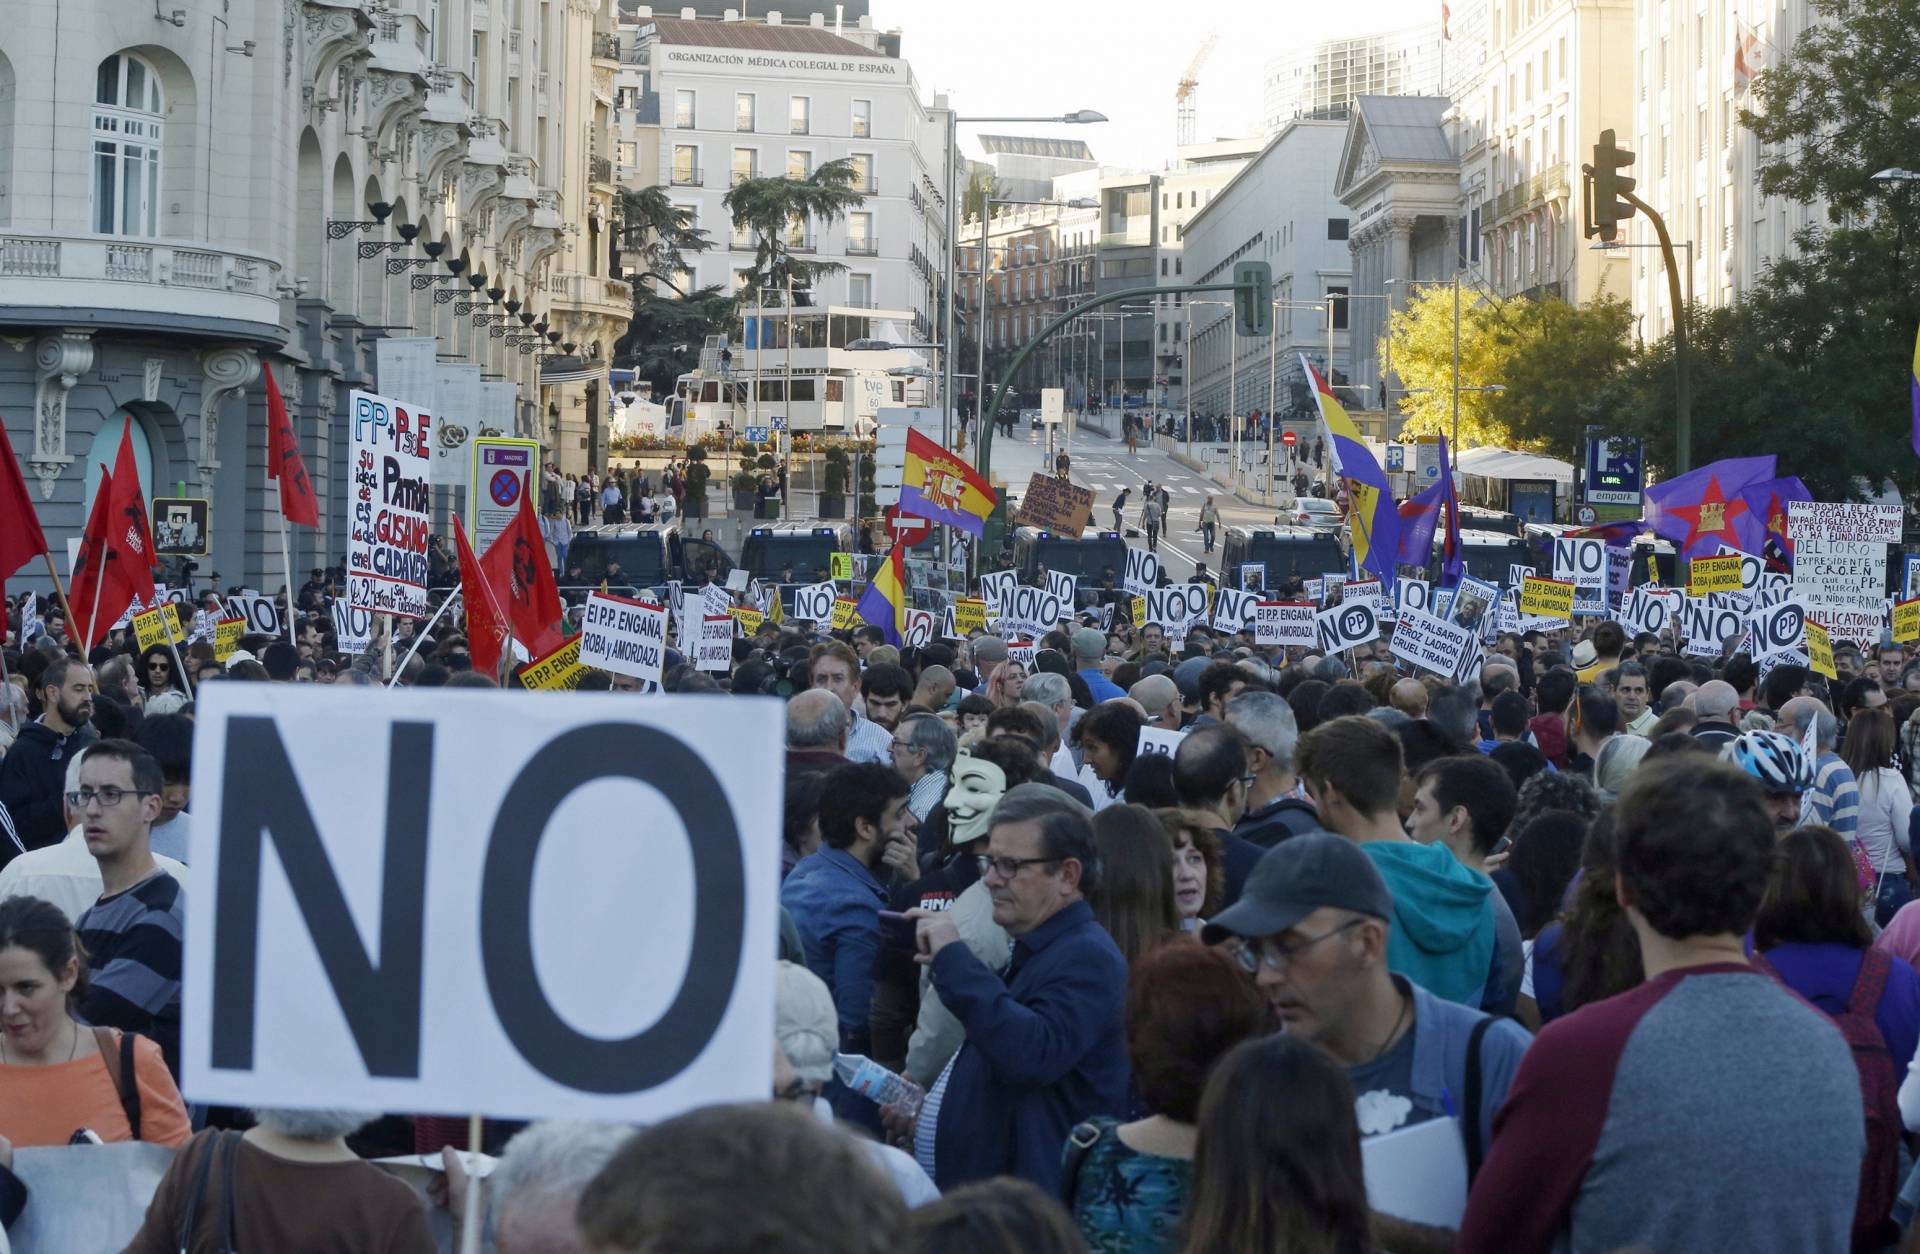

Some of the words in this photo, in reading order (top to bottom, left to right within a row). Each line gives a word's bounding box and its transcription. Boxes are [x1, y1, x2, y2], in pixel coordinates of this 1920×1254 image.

[668, 51, 743, 65] ORGANIZACIÓN
[748, 54, 786, 68] MÉDICA
[789, 60, 838, 71] COLEGIAL
[841, 62, 854, 72] DE
[858, 62, 896, 74] ESPAÑA
[864, 378, 883, 396] tve
[869, 398, 879, 408] 60
[356, 467, 378, 489] idea
[1602, 476, 1621, 484] LIBRE
[358, 485, 371, 502] de
[1596, 492, 1632, 502] empark
[356, 502, 372, 524] es
[1790, 502, 1844, 512] PARADOJAS
[1866, 506, 1878, 514] LA
[1881, 506, 1902, 514] VIDA
[376, 509, 428, 555] GUSANO
[1798, 524, 1822, 532] OTRO
[1856, 526, 1894, 534] IGLESIAS
[1810, 532, 1822, 540] HA
[1126, 548, 1156, 585] NO
[1555, 540, 1602, 574] NO
[1796, 556, 1870, 566] EXPRESIDENTE
[1875, 560, 1886, 568] DE
[1046, 572, 1073, 606] NO
[1461, 581, 1480, 596] DORIS
[1480, 588, 1494, 602] VIVE
[1524, 582, 1531, 592] El
[1694, 576, 1708, 586] ROBA
[1798, 574, 1816, 584] DICE
[1822, 576, 1838, 584] QUE
[1860, 577, 1876, 588] PP
[1824, 584, 1861, 594] MURCIA
[796, 592, 830, 618] NO
[1025, 591, 1059, 626] NO
[1147, 590, 1186, 622] NO
[1438, 594, 1451, 603] DOR
[1522, 596, 1536, 607] ROBA
[1573, 601, 1589, 610] LUCHA
[1590, 601, 1604, 610] SIGUE
[1808, 594, 1821, 602] UN
[1826, 592, 1844, 603] NIDO
[1858, 596, 1884, 610] RATAS
[336, 600, 367, 638] NO
[1258, 609, 1264, 620] El
[1266, 609, 1279, 620] P.P.
[1280, 608, 1315, 624] ENGAÑA,
[1628, 590, 1664, 632] NO
[587, 604, 598, 623] El
[599, 608, 616, 628] P.P.
[618, 614, 663, 644] ENGAÑA,
[1258, 625, 1274, 636] ROBA
[1274, 628, 1279, 639] y
[1280, 626, 1314, 637] AMORDAZA.
[1318, 604, 1374, 651] NO
[1347, 614, 1364, 632] PP
[1420, 620, 1464, 647] FALSARIO,
[1692, 608, 1740, 643] NO
[1752, 604, 1804, 658] NO
[1780, 614, 1797, 636] PP
[583, 632, 606, 655] ROBA
[606, 642, 612, 661] y
[612, 639, 660, 669] AMORDAZA.
[1396, 624, 1423, 642] FEROZ
[1424, 636, 1459, 659] LADRÓN,
[1700, 646, 1714, 654] mafia
[1393, 636, 1419, 655] CRUEL
[1422, 648, 1454, 670] TIRANO.
[210, 715, 746, 1095] NO
